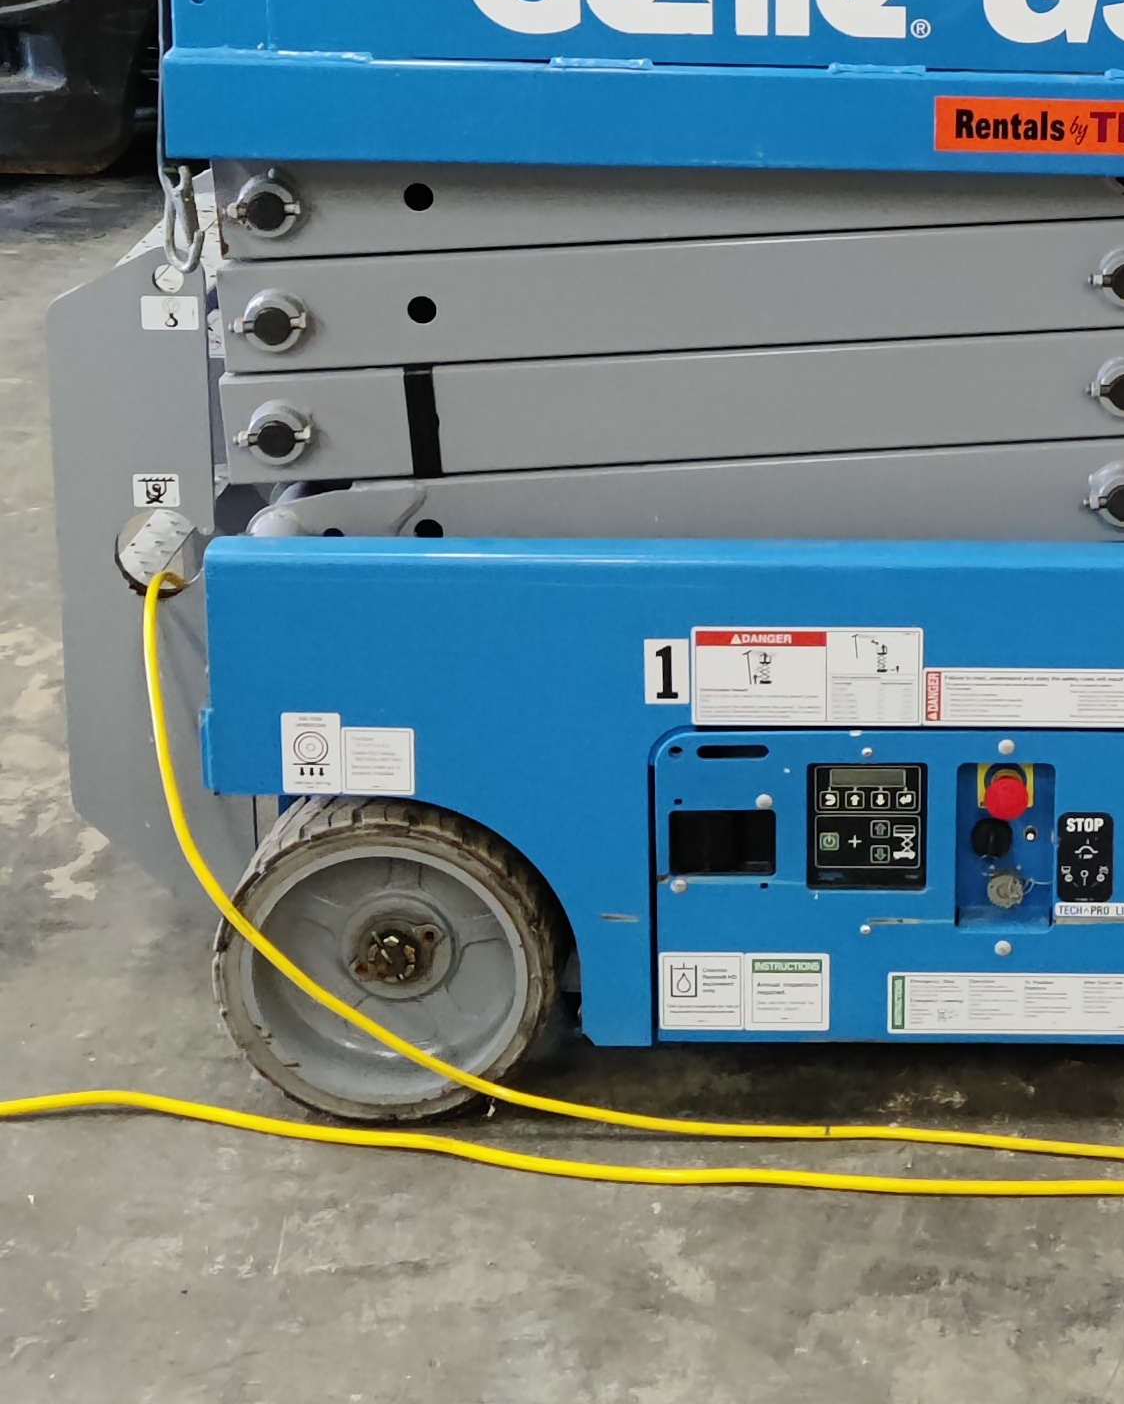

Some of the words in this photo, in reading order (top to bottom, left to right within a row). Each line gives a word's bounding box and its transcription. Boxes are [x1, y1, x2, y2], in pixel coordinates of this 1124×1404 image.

[954, 108, 1065, 142] Rentals
[1069, 115, 1089, 146] by
[741, 633, 792, 644] DANGER
[655, 645, 679, 699] 1
[928, 672, 940, 713] DANGER
[1065, 817, 1104, 833] STOP
[754, 961, 820, 972] INSTRUCTIONS
